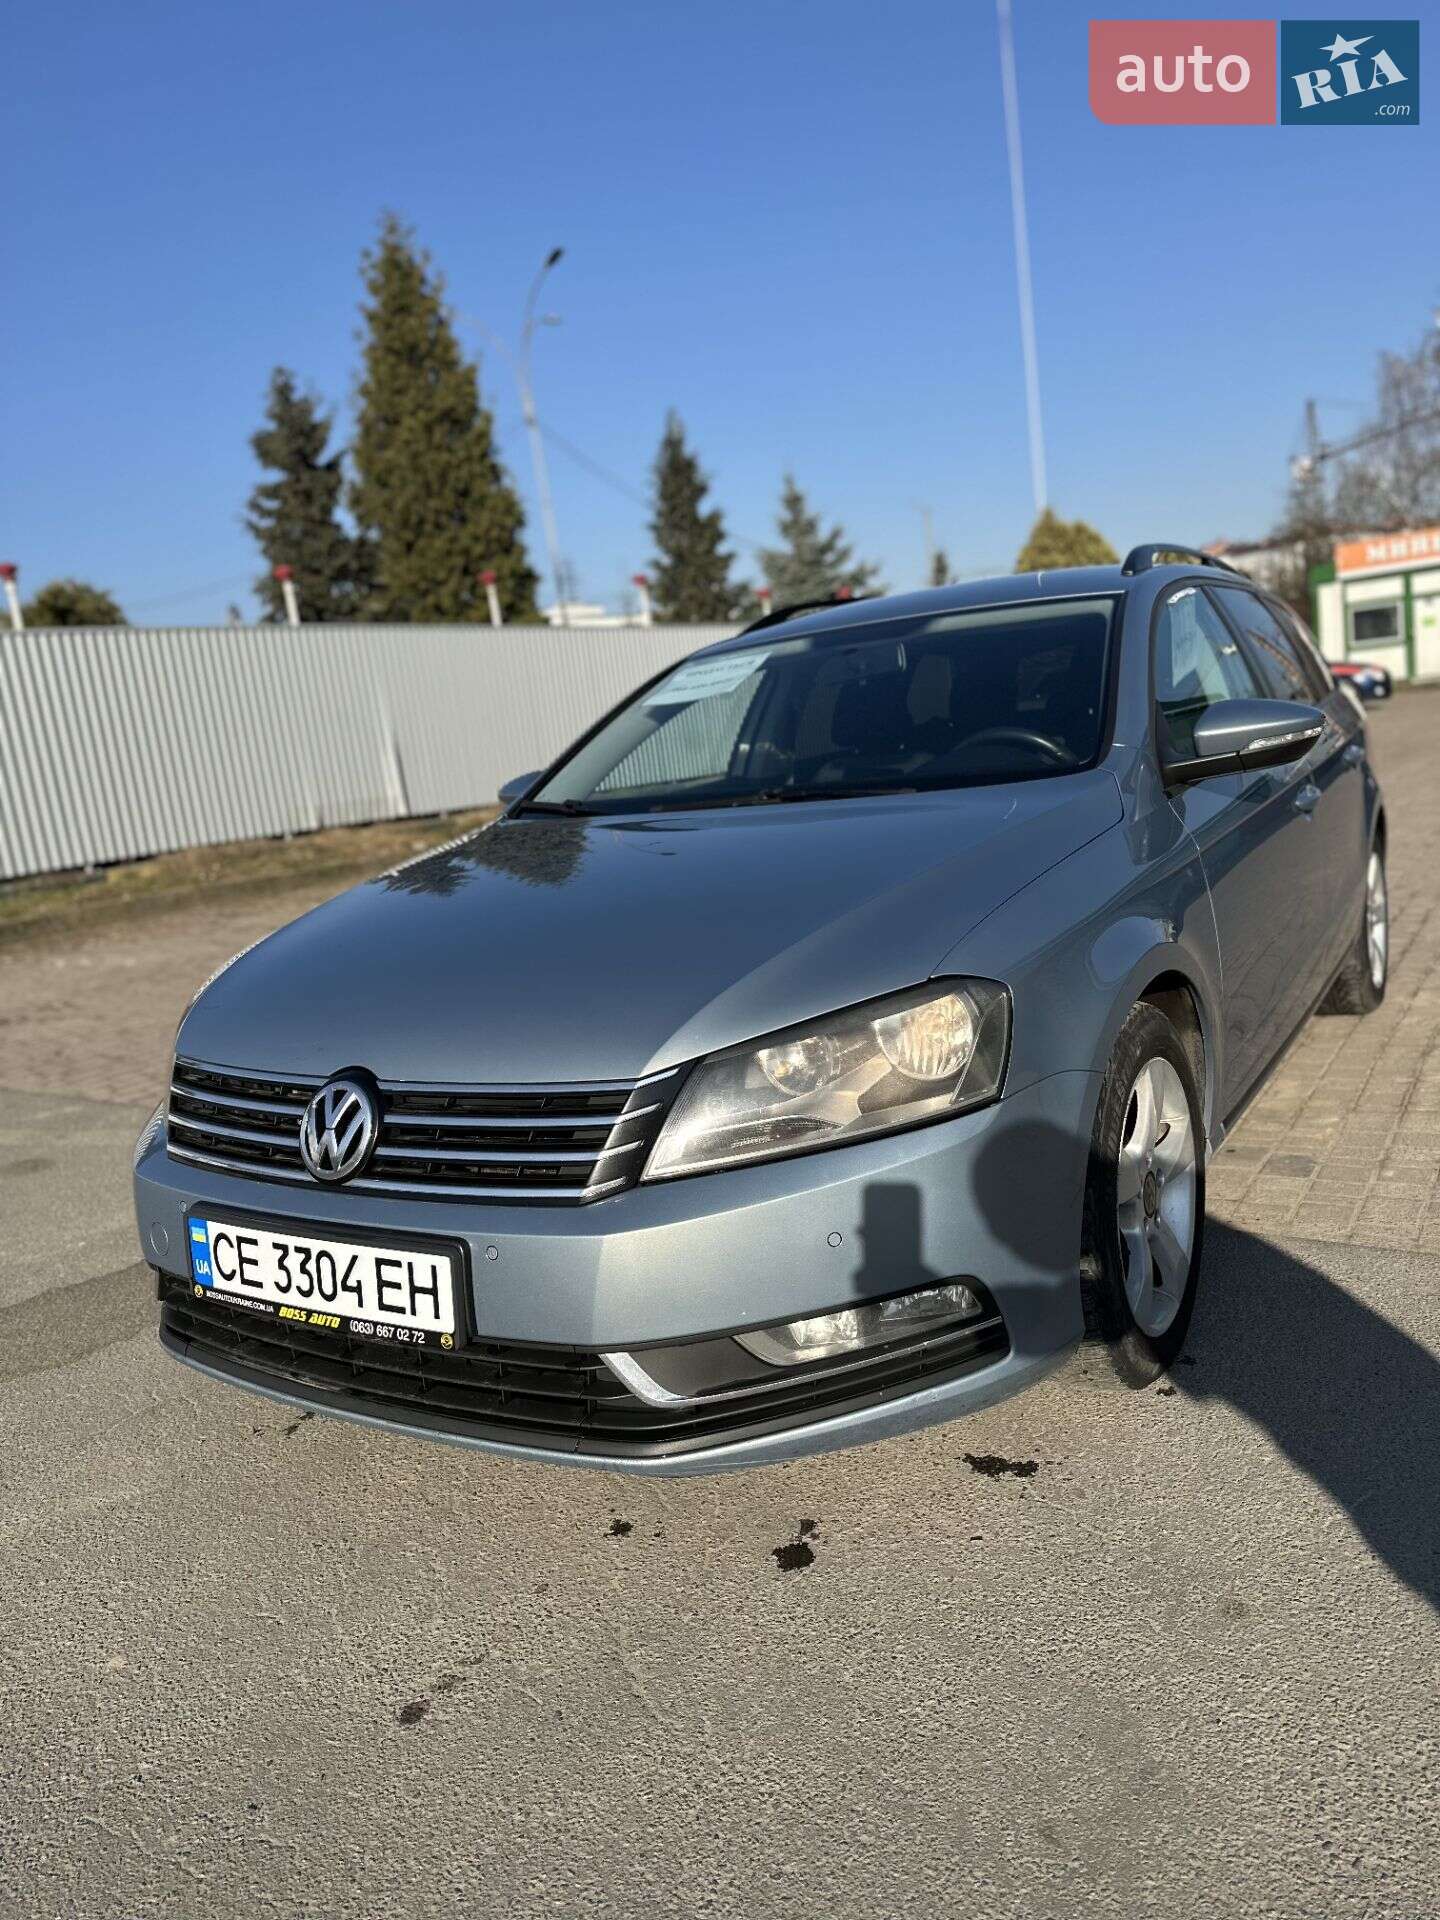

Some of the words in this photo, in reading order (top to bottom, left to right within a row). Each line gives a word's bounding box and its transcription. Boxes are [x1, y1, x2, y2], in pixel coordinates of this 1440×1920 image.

[196, 1259, 211, 1276] UA
[212, 1231, 264, 1289] CE
[271, 1241, 364, 1308] 3304
[374, 1256, 441, 1320] EH
[278, 1306, 307, 1322] BOSS
[308, 1313, 341, 1329] AUTO
[349, 1319, 374, 1335] (063)
[376, 1324, 395, 1338] 667
[396, 1328, 410, 1342] 02
[412, 1331, 426, 1344] 72
